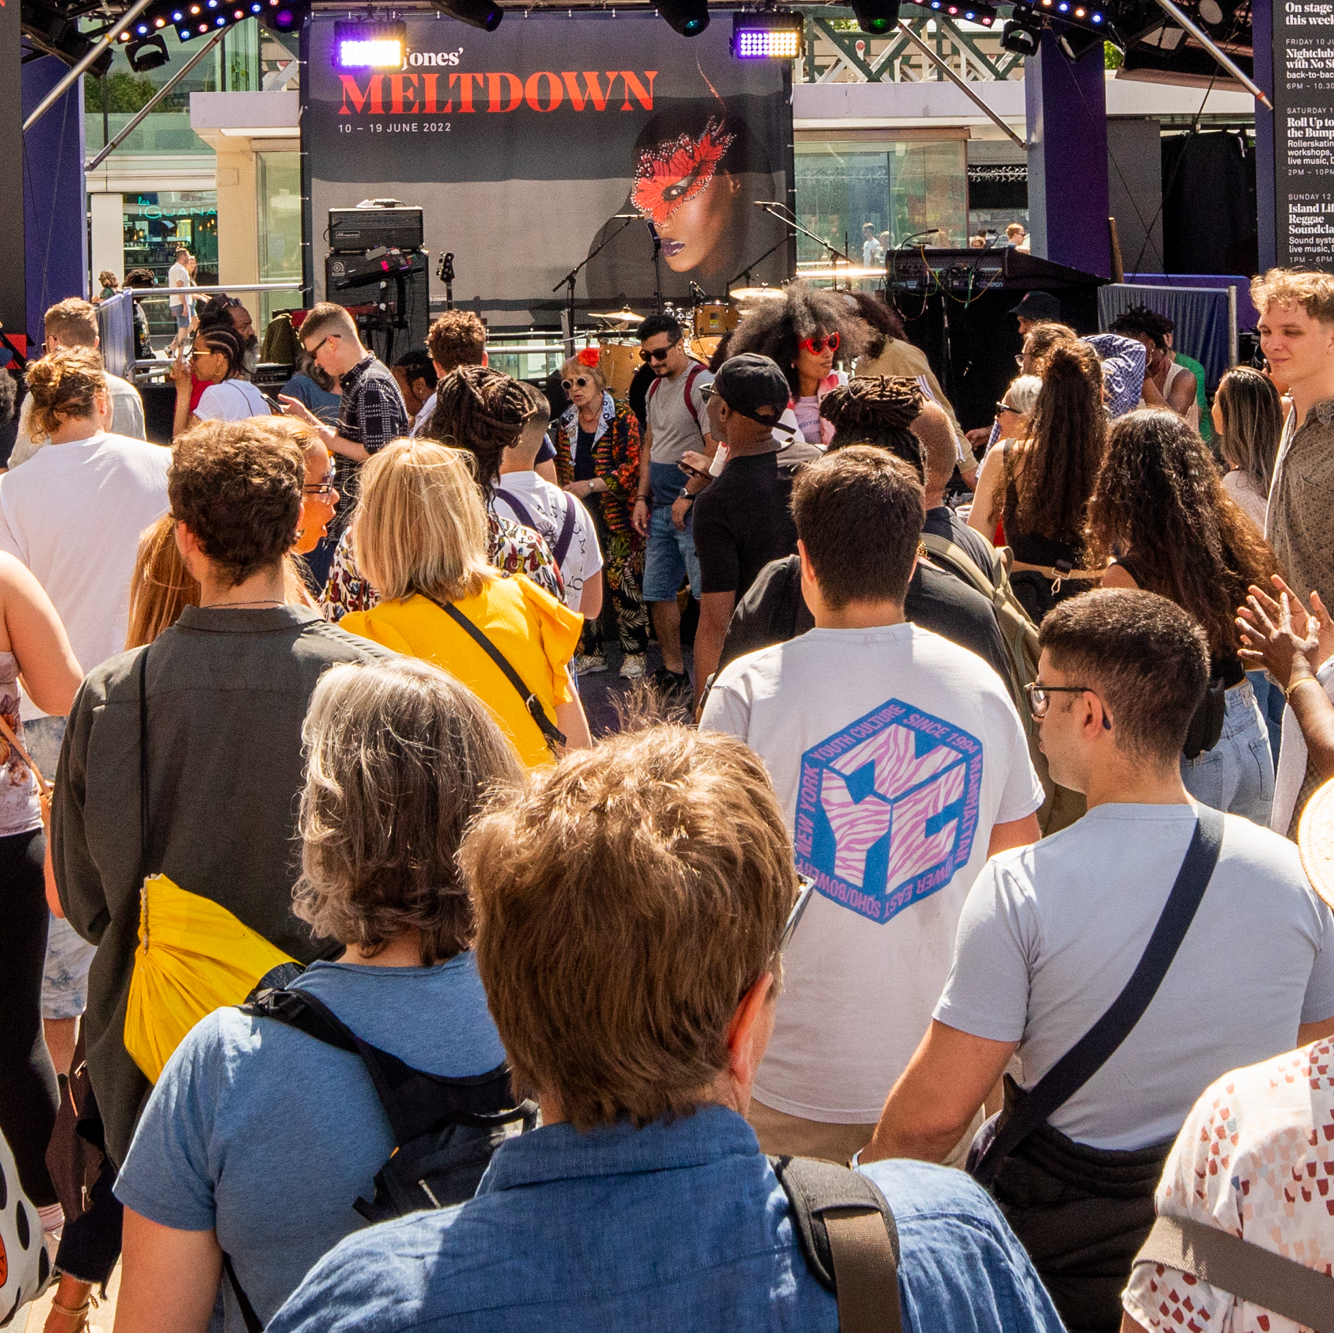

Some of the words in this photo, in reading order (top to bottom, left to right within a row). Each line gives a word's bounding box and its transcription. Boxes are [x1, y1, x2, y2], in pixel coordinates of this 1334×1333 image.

[1285, 2, 1302, 12] On
[1304, 3, 1333, 16] stage
[1286, 15, 1307, 25] this
[1286, 58, 1308, 68] with
[1310, 59, 1324, 68] No
[337, 71, 658, 115] MELTDOWN
[338, 124, 353, 134] 10
[369, 123, 383, 133] 19
[387, 123, 418, 133] JUNE
[423, 122, 451, 132] 2022
[1287, 117, 1306, 128] Roll
[1306, 117, 1322, 130] Up
[1322, 118, 1334, 126] to
[1287, 127, 1303, 137] the
[1288, 148, 1333, 157] workshops,
[1288, 156, 1301, 164] live
[1303, 156, 1329, 165] music,
[1289, 203, 1319, 213] Island
[1289, 214, 1324, 227] Reggae
[1289, 236, 1314, 244] Sound
[1289, 244, 1303, 253] live
[1304, 244, 1330, 253] music,
[809, 733, 855, 762] YOUTH
[850, 703, 907, 739] CULTURE
[902, 713, 948, 739] SINCE
[946, 731, 980, 755] 1994
[801, 762, 820, 813] YORK
[954, 752, 983, 864] MANHATTAN
[796, 813, 816, 859] NEW
[916, 854, 956, 890] OWER
[882, 881, 914, 919] EAST
